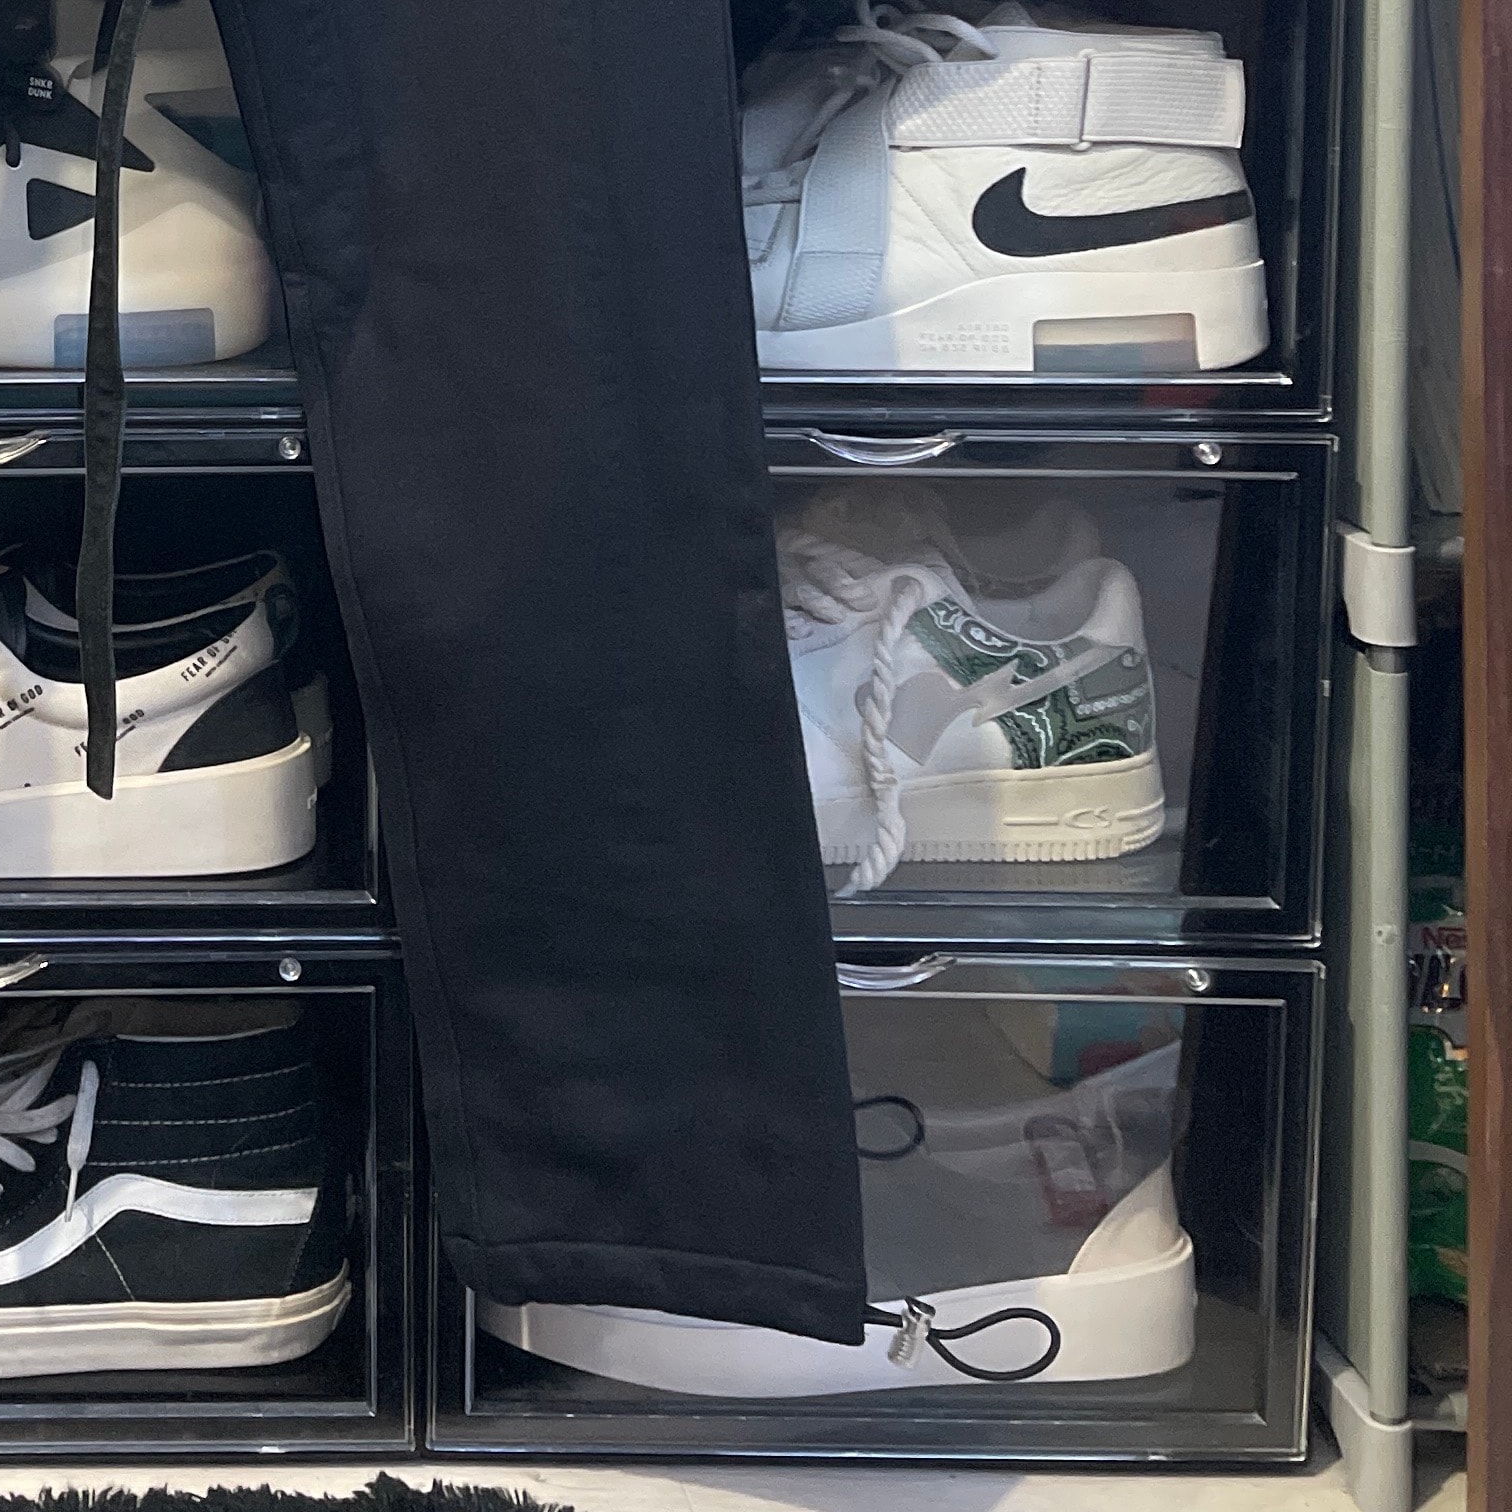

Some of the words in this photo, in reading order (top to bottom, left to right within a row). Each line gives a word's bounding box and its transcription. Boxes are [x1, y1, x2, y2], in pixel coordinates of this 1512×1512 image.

[28, 87, 53, 100] DUNK
[181, 656, 208, 681] FEAR
[20, 684, 43, 704] GOD
